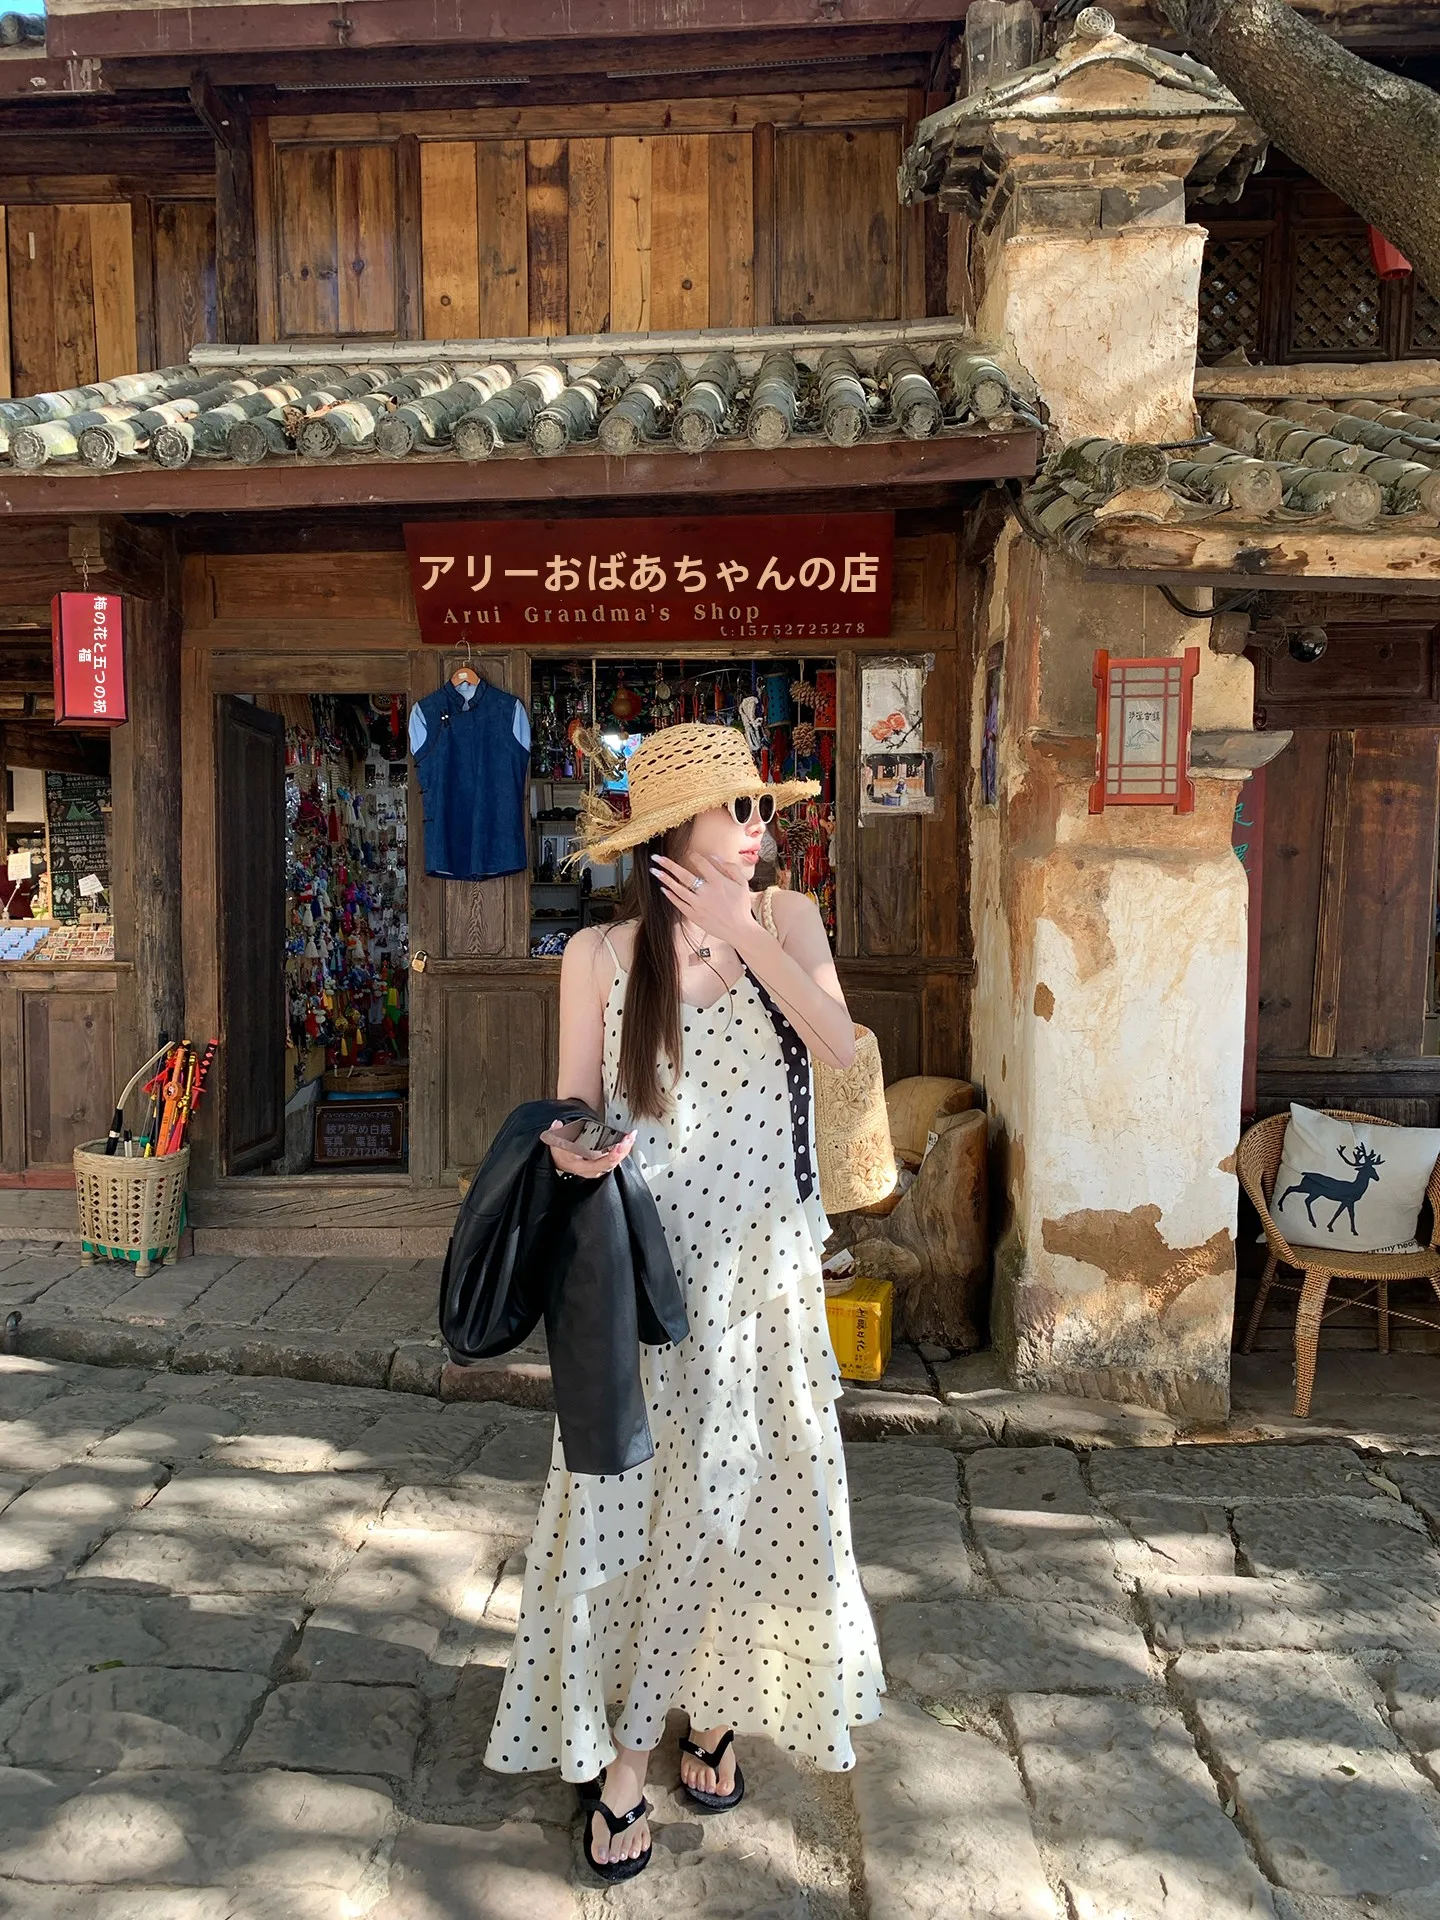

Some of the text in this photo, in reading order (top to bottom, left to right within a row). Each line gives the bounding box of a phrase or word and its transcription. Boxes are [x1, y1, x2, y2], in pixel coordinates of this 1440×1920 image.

[419, 551, 879, 593] アリーおばあちゃんの店
[443, 603, 760, 623] Arui Grandma's Shop
